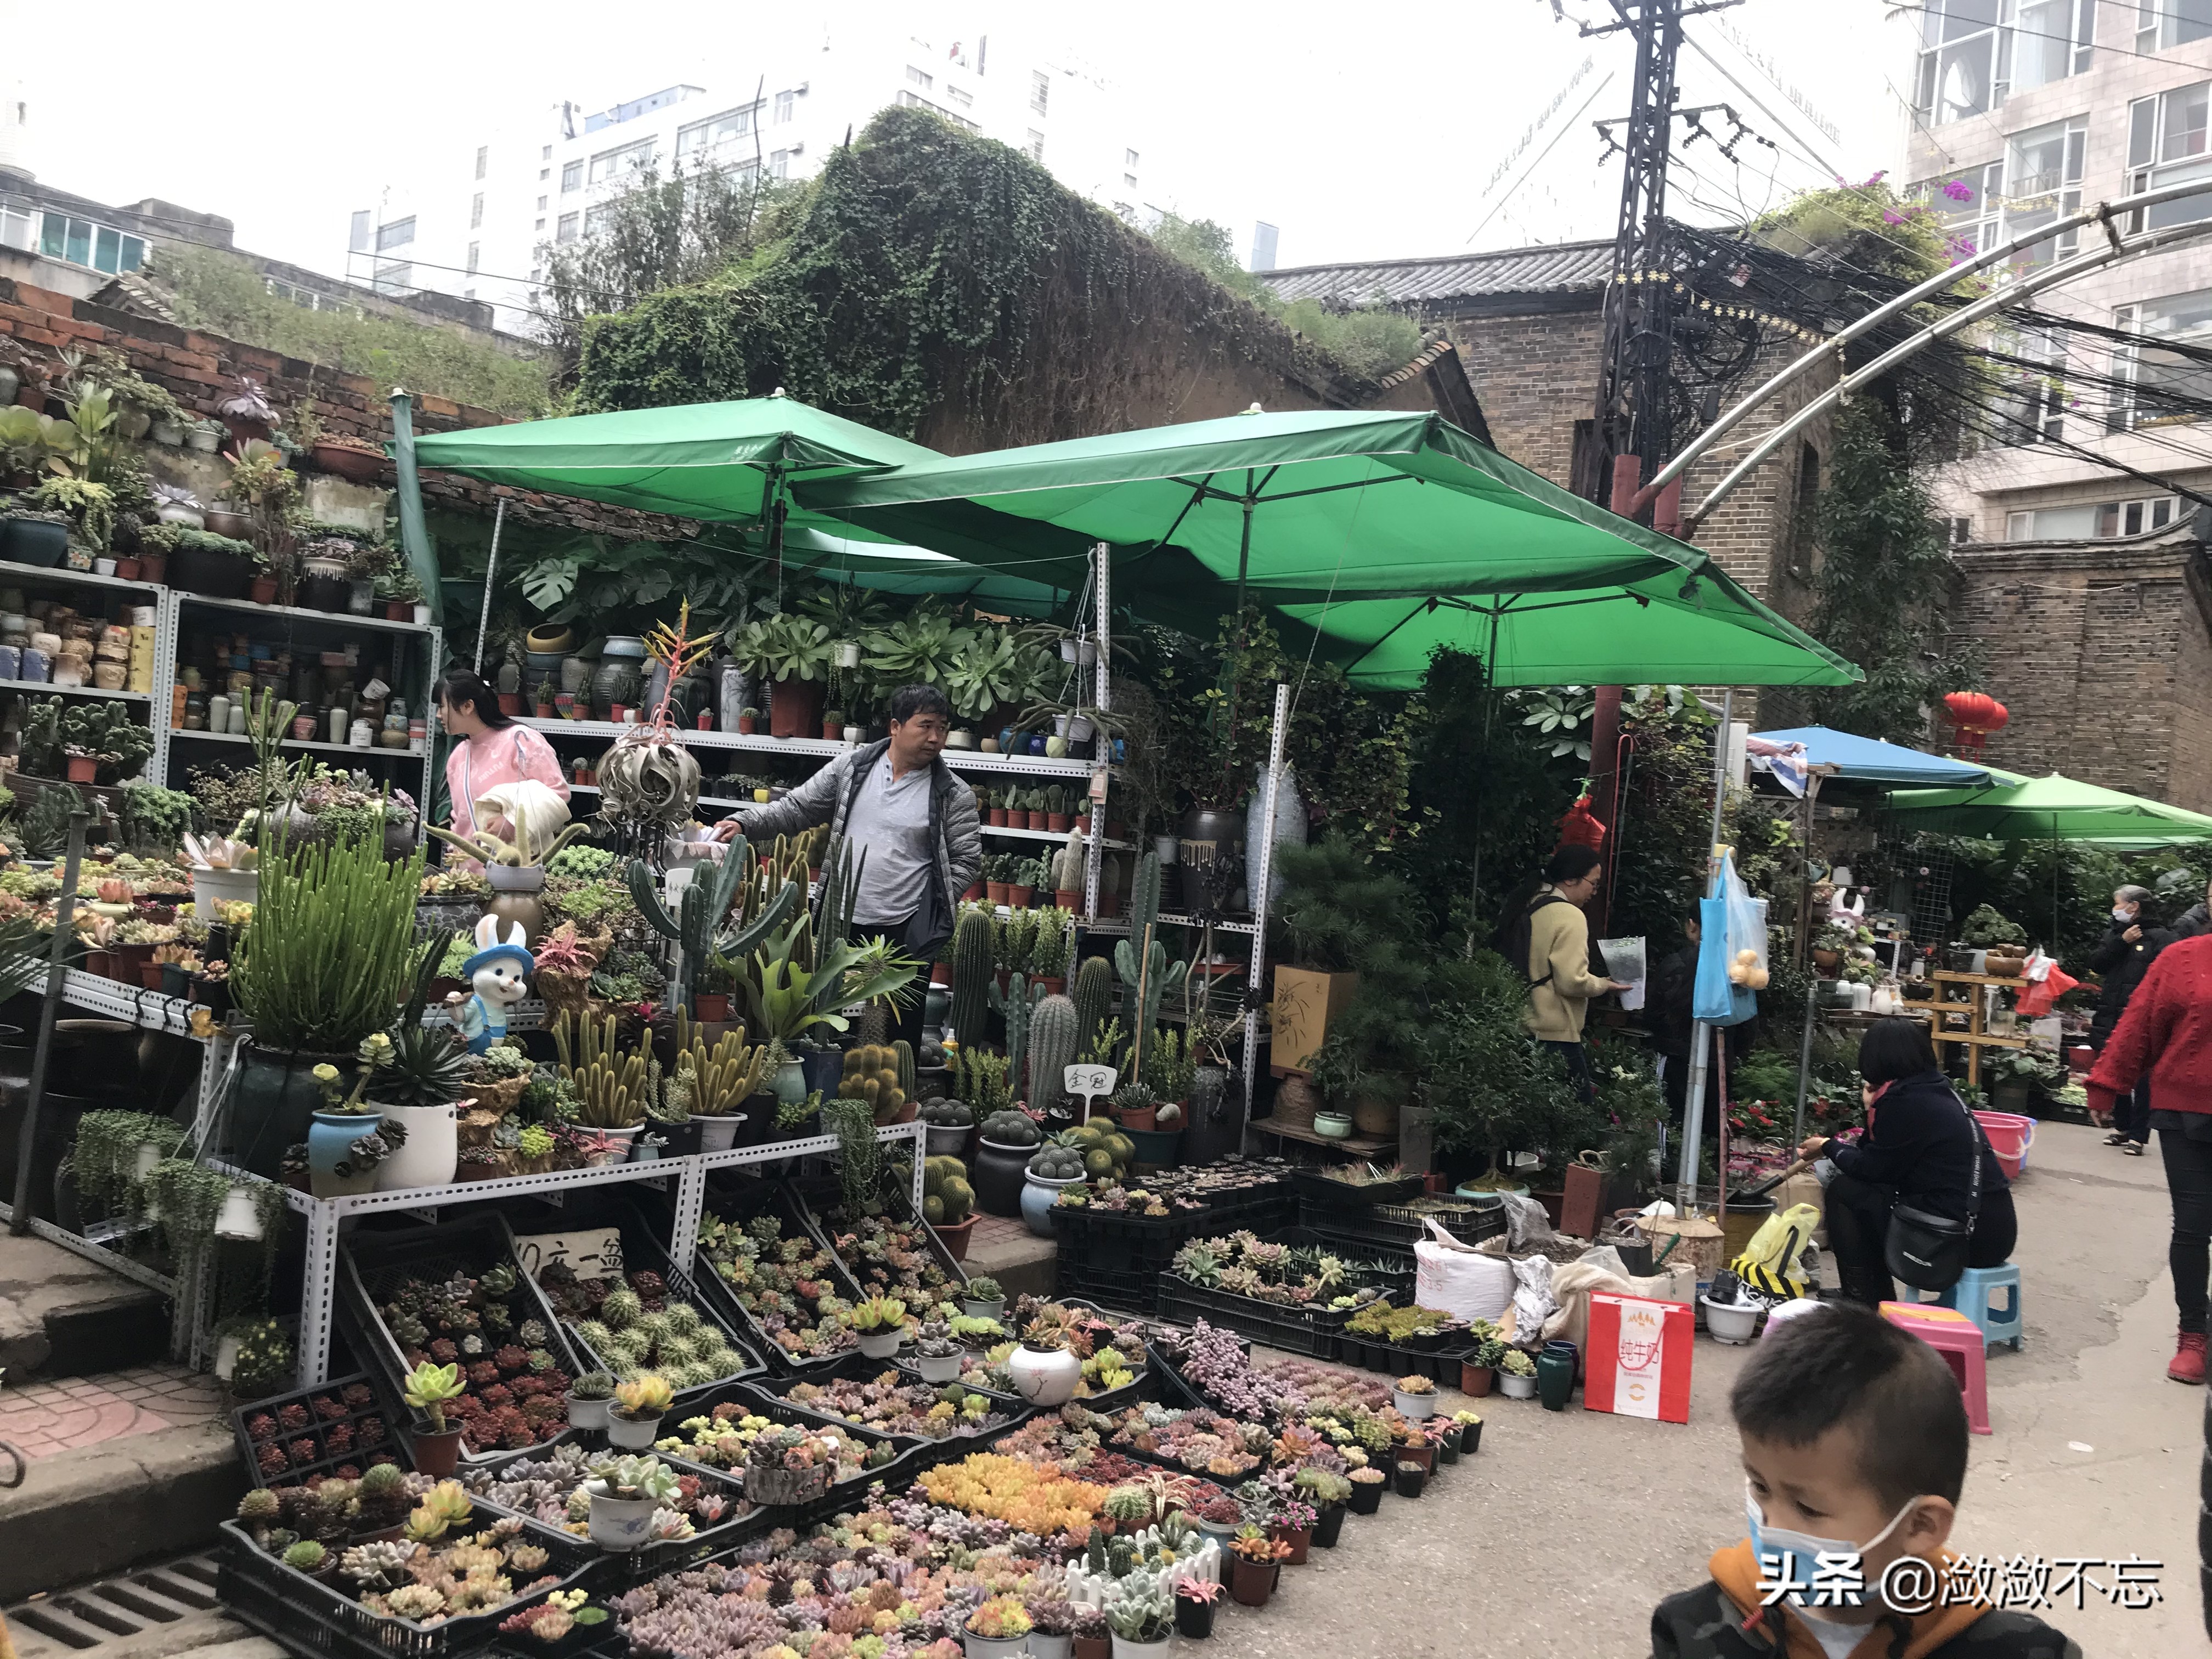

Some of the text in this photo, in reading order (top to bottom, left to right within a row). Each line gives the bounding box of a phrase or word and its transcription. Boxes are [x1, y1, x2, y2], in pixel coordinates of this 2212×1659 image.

[1068, 1069, 1107, 1090] 金冠
[1620, 1339, 1659, 1364] 纯牛奶
